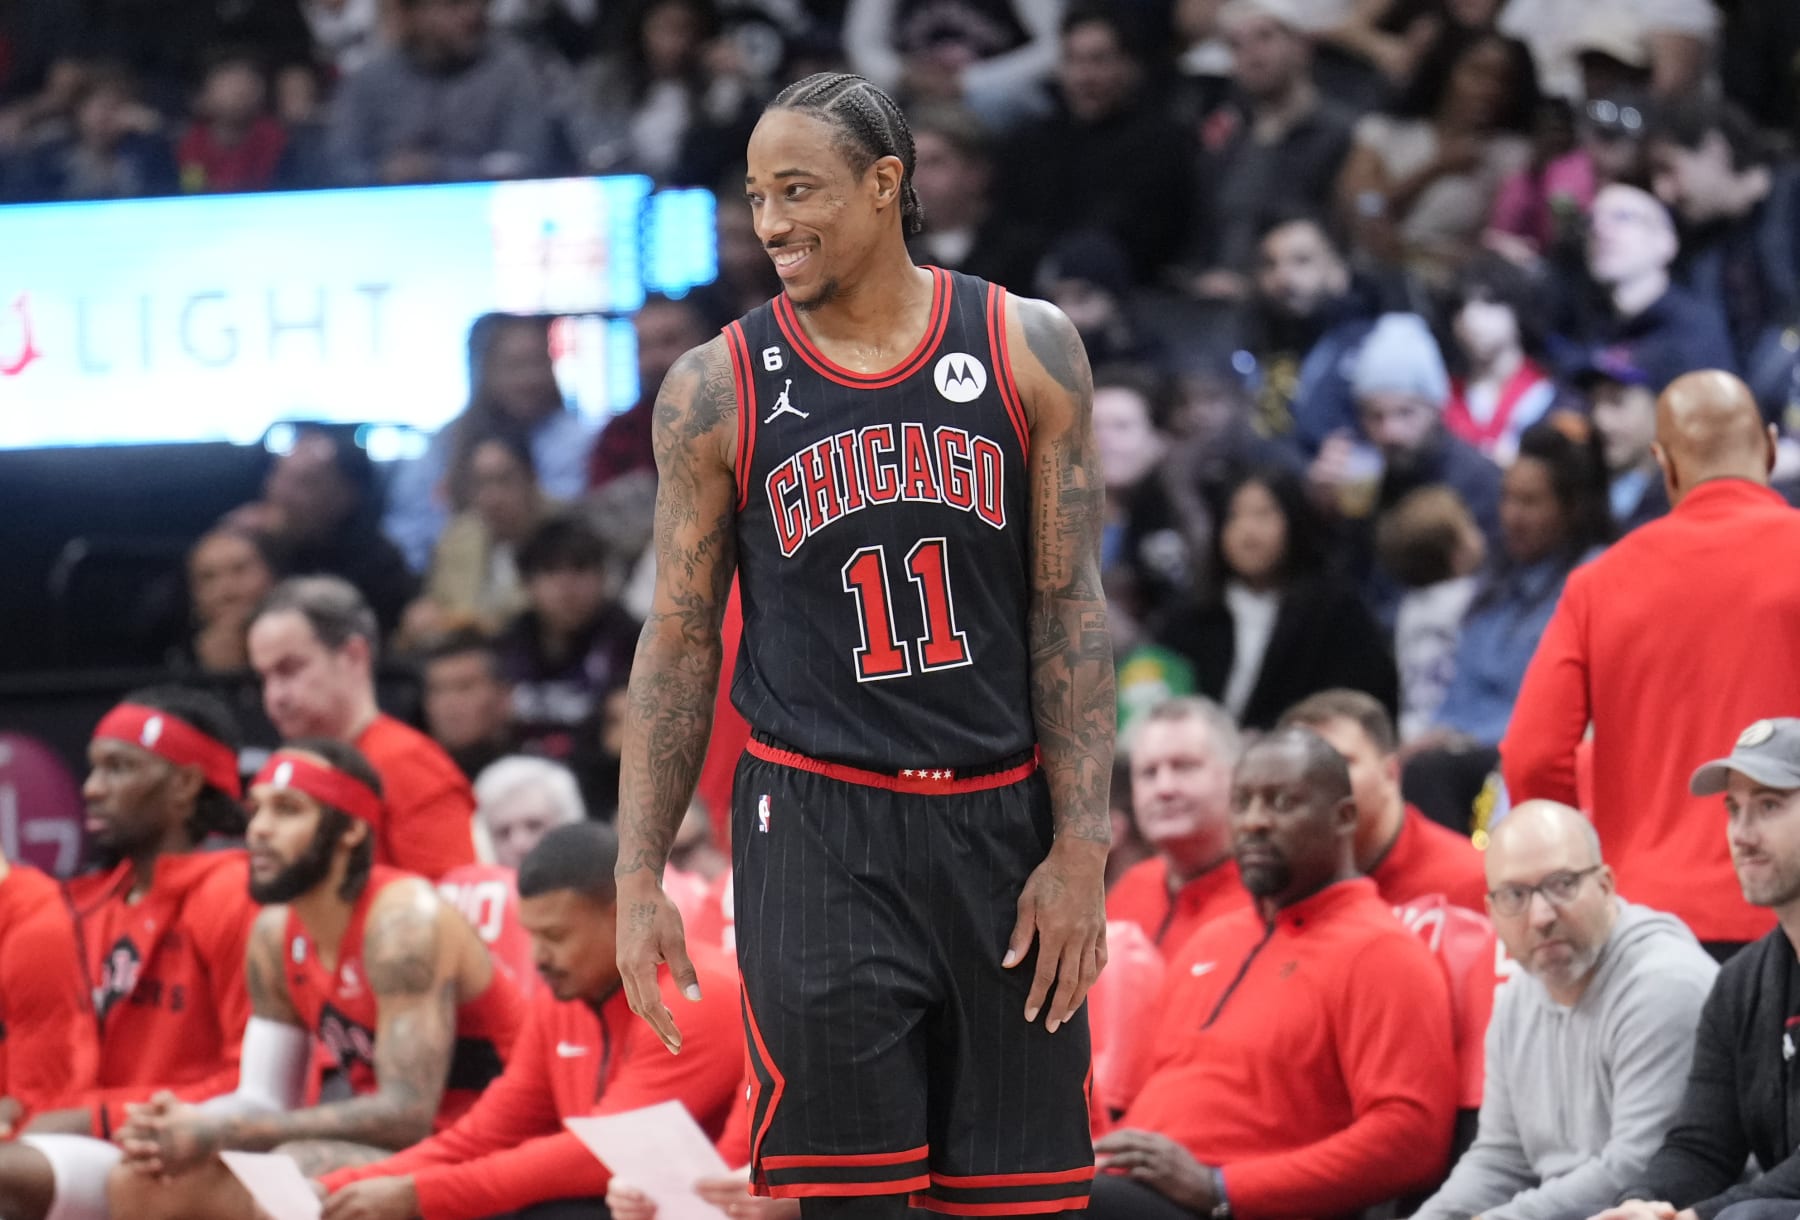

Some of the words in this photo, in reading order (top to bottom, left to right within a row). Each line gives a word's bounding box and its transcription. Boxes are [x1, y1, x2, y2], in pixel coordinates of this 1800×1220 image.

[77, 282, 393, 371] LIGHT
[762, 345, 783, 371] 6
[765, 422, 1006, 558] CHICAGO
[841, 536, 973, 683] 11
